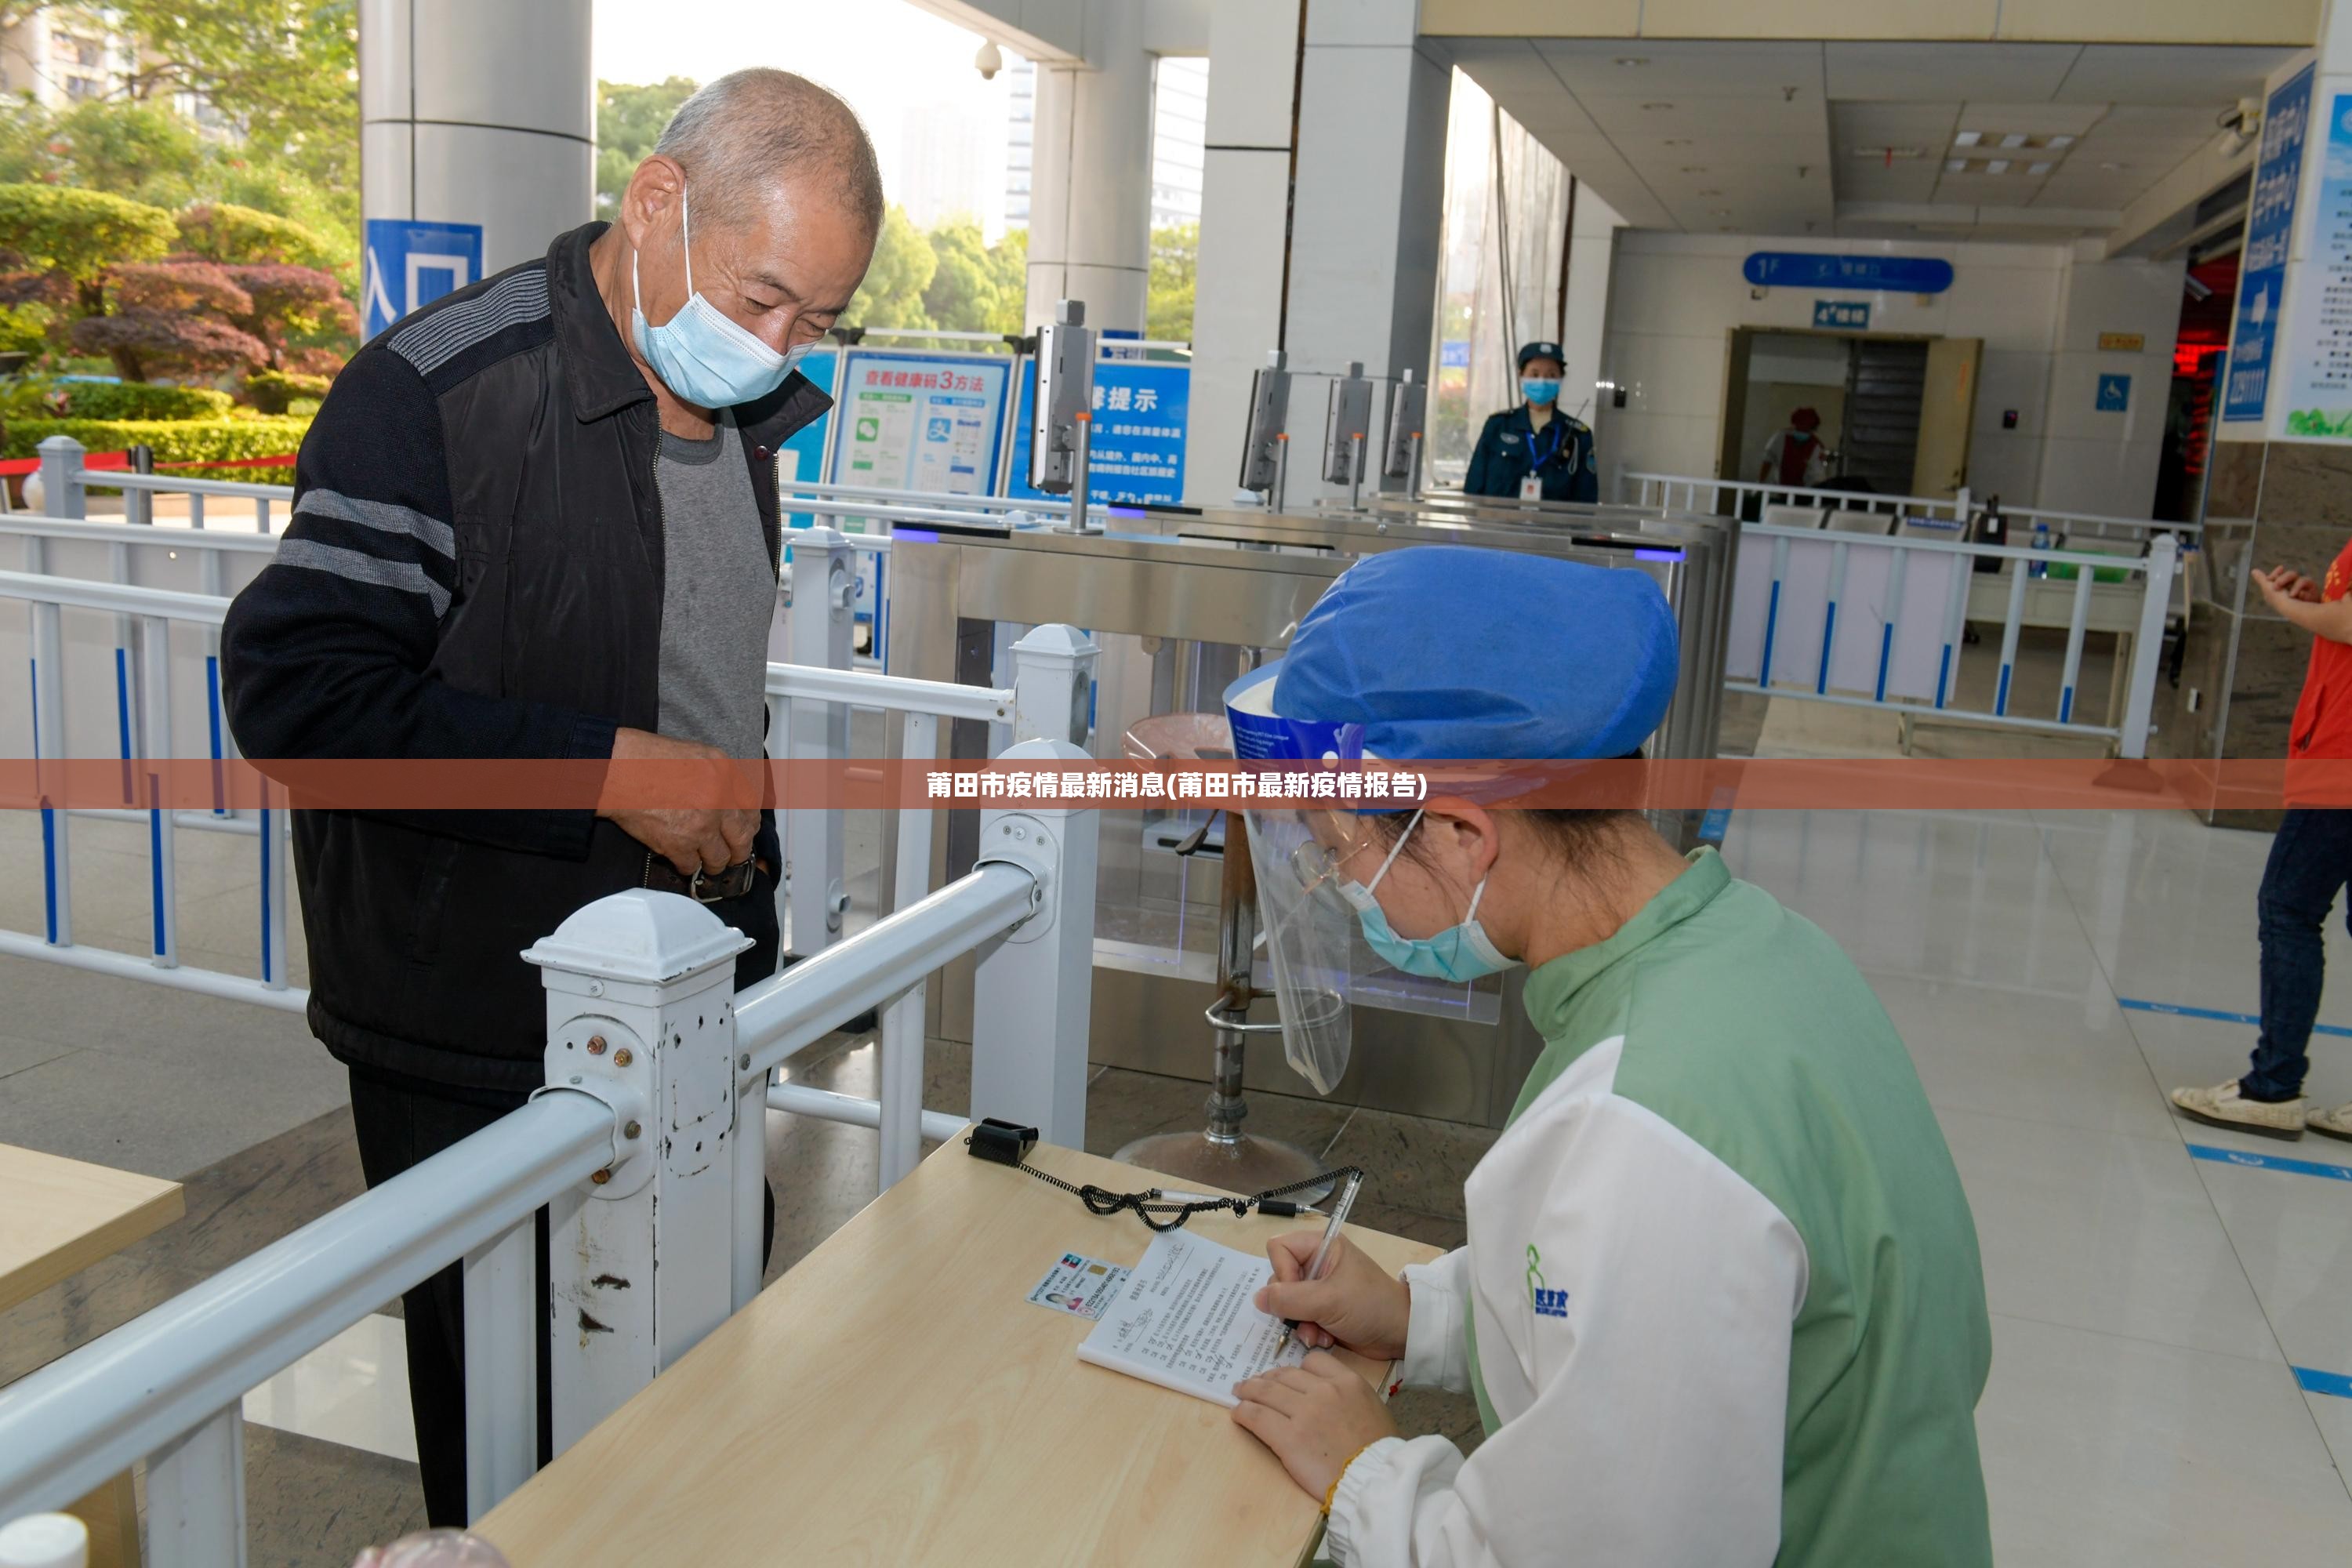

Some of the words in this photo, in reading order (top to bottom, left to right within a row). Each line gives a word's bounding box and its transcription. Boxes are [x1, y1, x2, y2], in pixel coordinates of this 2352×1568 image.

[366, 246, 468, 324] 入口
[866, 370, 985, 392] 查看健康码3方法
